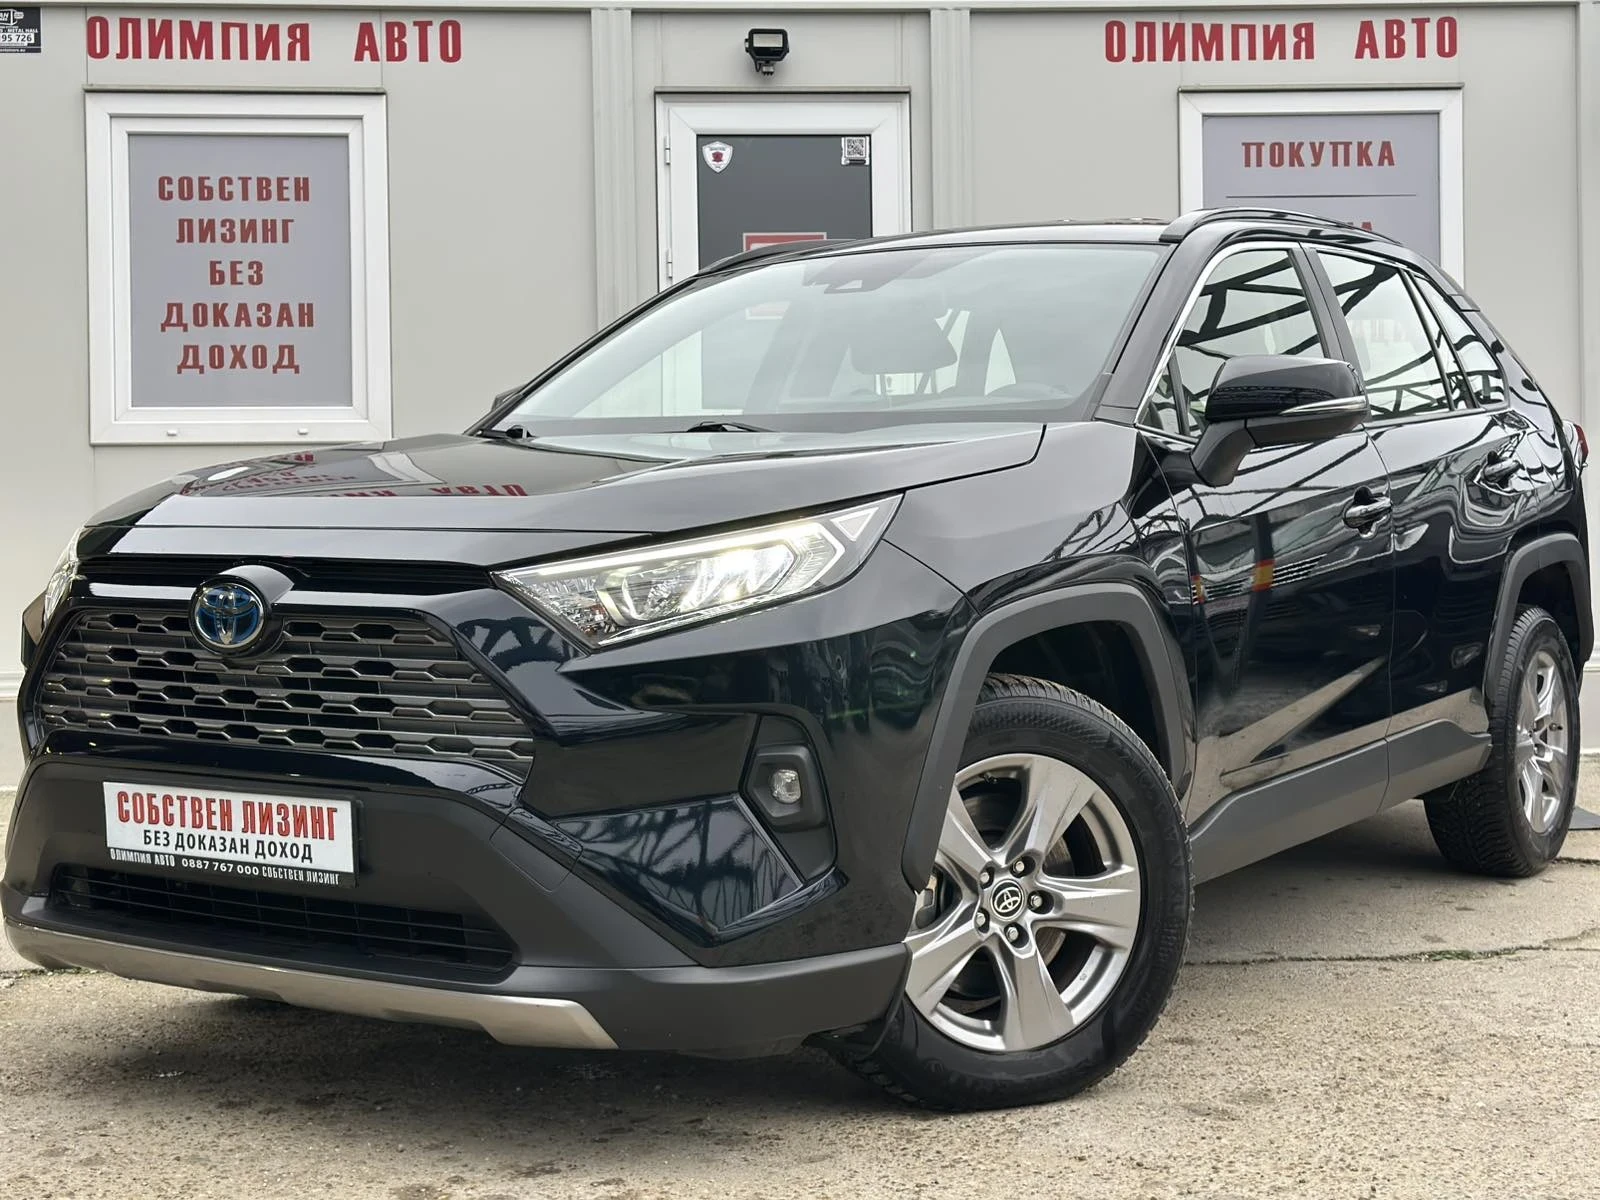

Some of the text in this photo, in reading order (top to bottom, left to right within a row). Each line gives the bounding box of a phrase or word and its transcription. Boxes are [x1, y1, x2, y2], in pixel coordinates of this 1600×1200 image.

[15, 34, 32, 42] 726
[86, 15, 463, 64] ОЛИМПИЯ АВТО
[1104, 16, 1459, 63] ОЛИМПИЯ АВТО
[1241, 140, 1395, 168] ПОКУПКА
[157, 175, 311, 202] СОБСТВЕН
[175, 218, 295, 244] ЛИЗИНГ
[209, 260, 264, 286] БЕЗ
[160, 302, 315, 332] ДОКАЗАН
[176, 344, 301, 375] ДОХОД
[116, 790, 338, 841] СОБСТВЕН ЛИЗИНГ
[143, 829, 314, 864] БЕЗ ДОКАЗАН ДОХОД
[110, 848, 340, 886] ОЛИМПИЯ АВТО 0887 767 000 СОБСТВЕН ЛИЗИНГ
